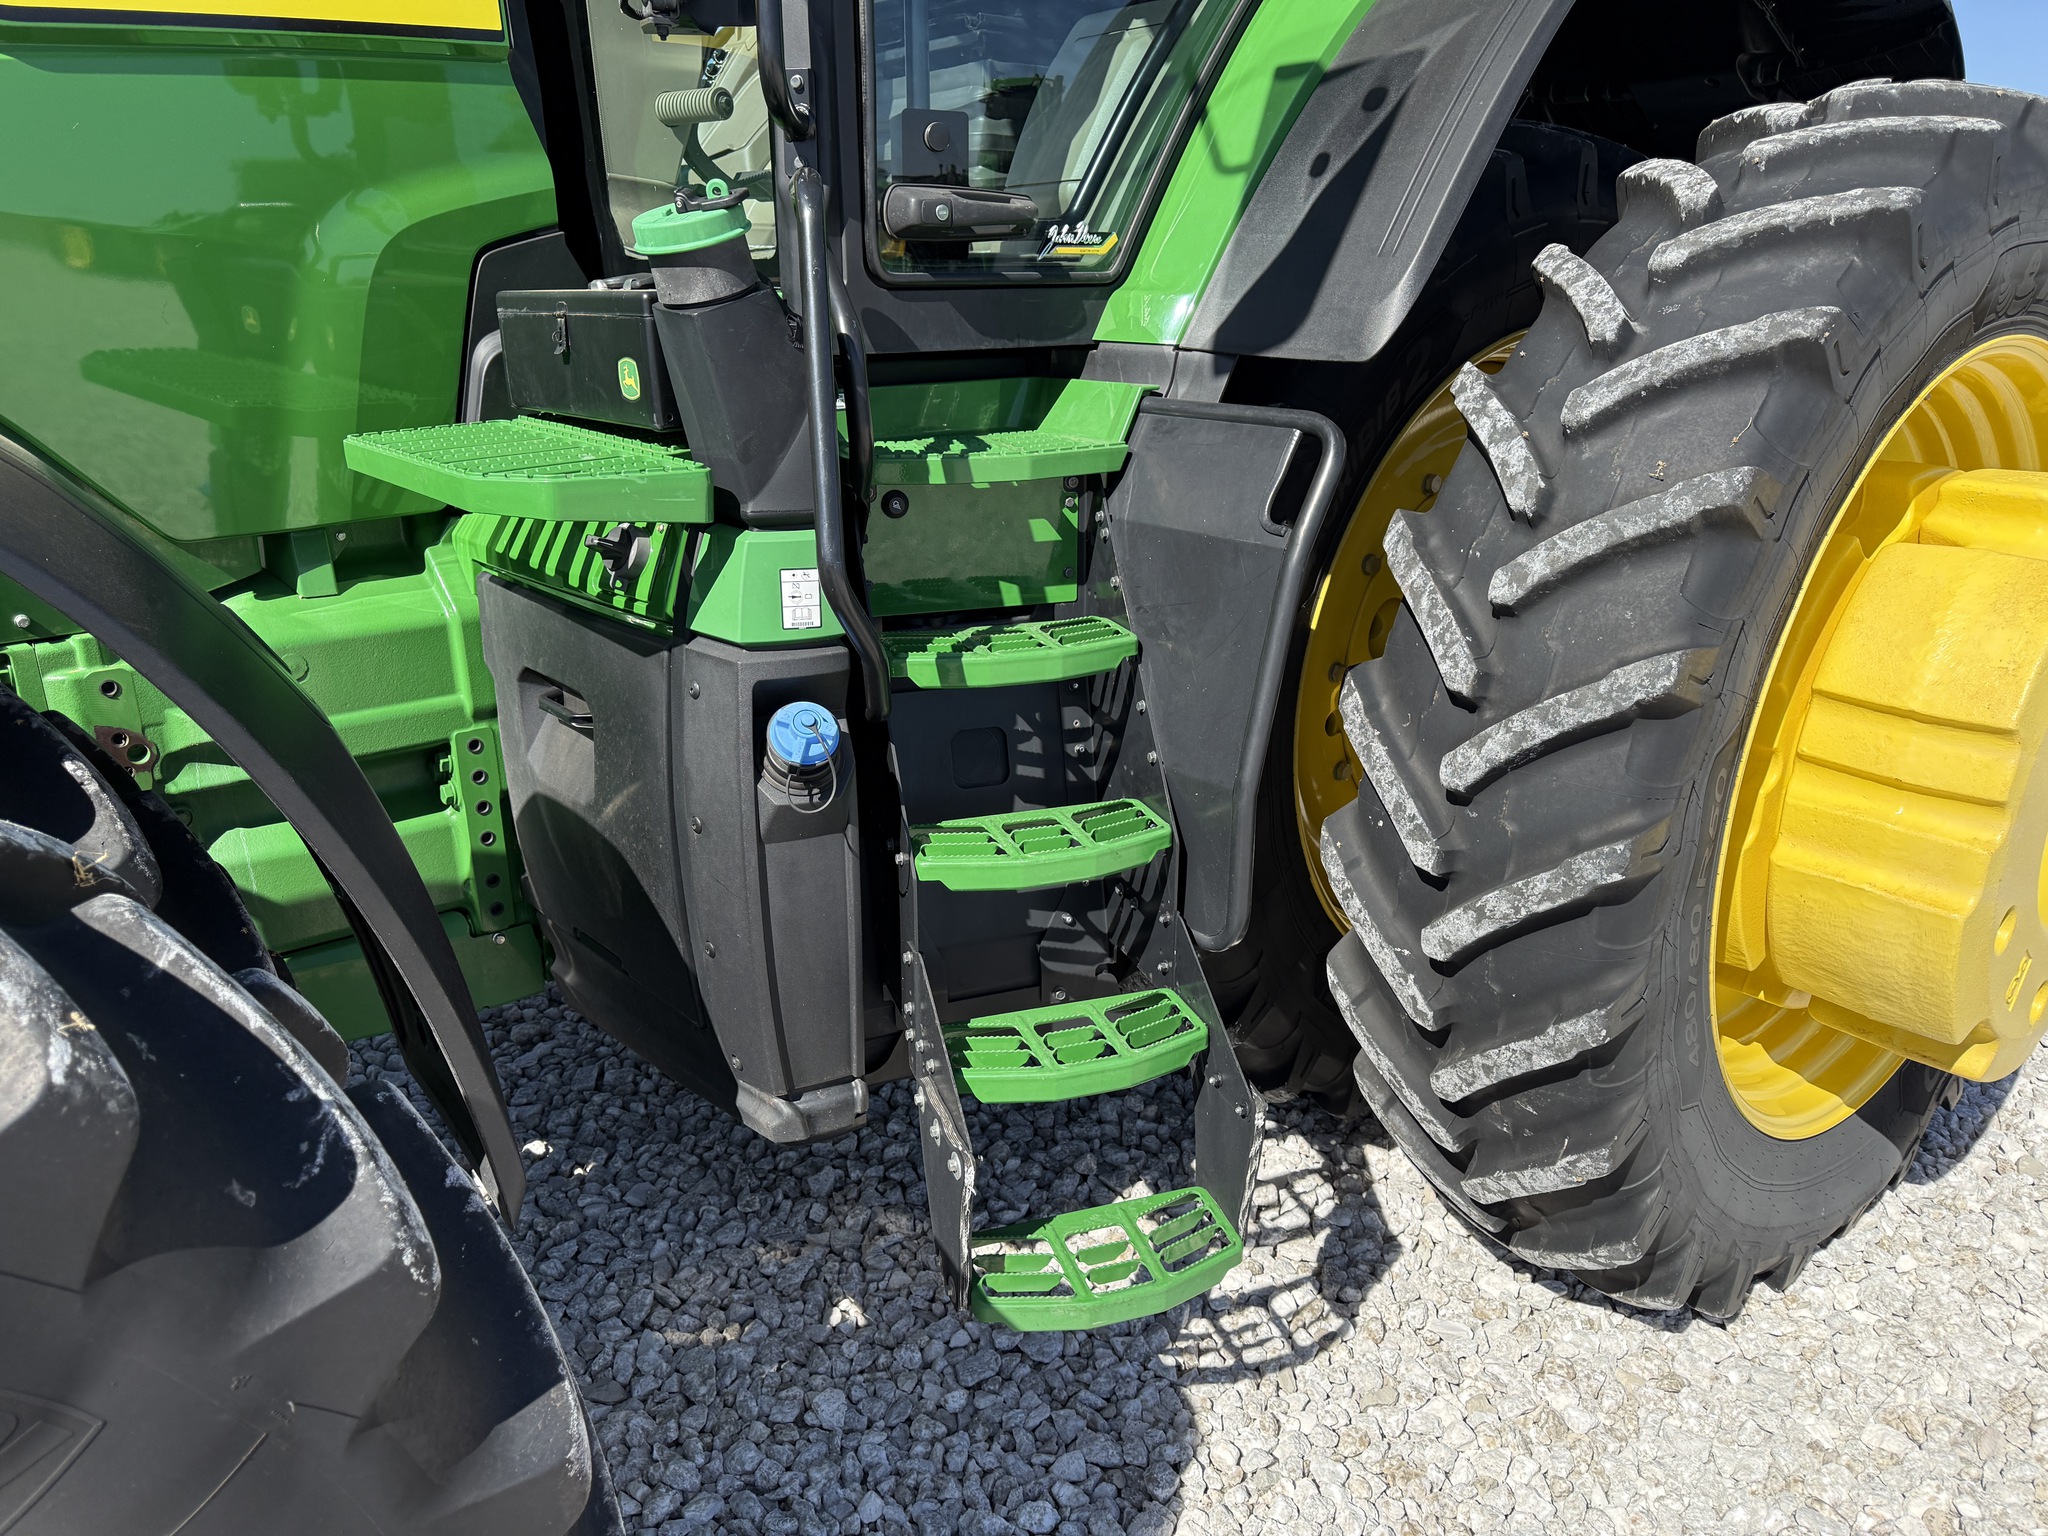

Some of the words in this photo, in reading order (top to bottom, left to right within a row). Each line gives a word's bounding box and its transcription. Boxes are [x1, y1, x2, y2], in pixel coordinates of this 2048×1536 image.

[1038, 224, 1075, 261] John
[1075, 221, 1102, 244] Deere
[1404, 336, 1432, 406] 2
[1684, 904, 1702, 1067] 480/80
